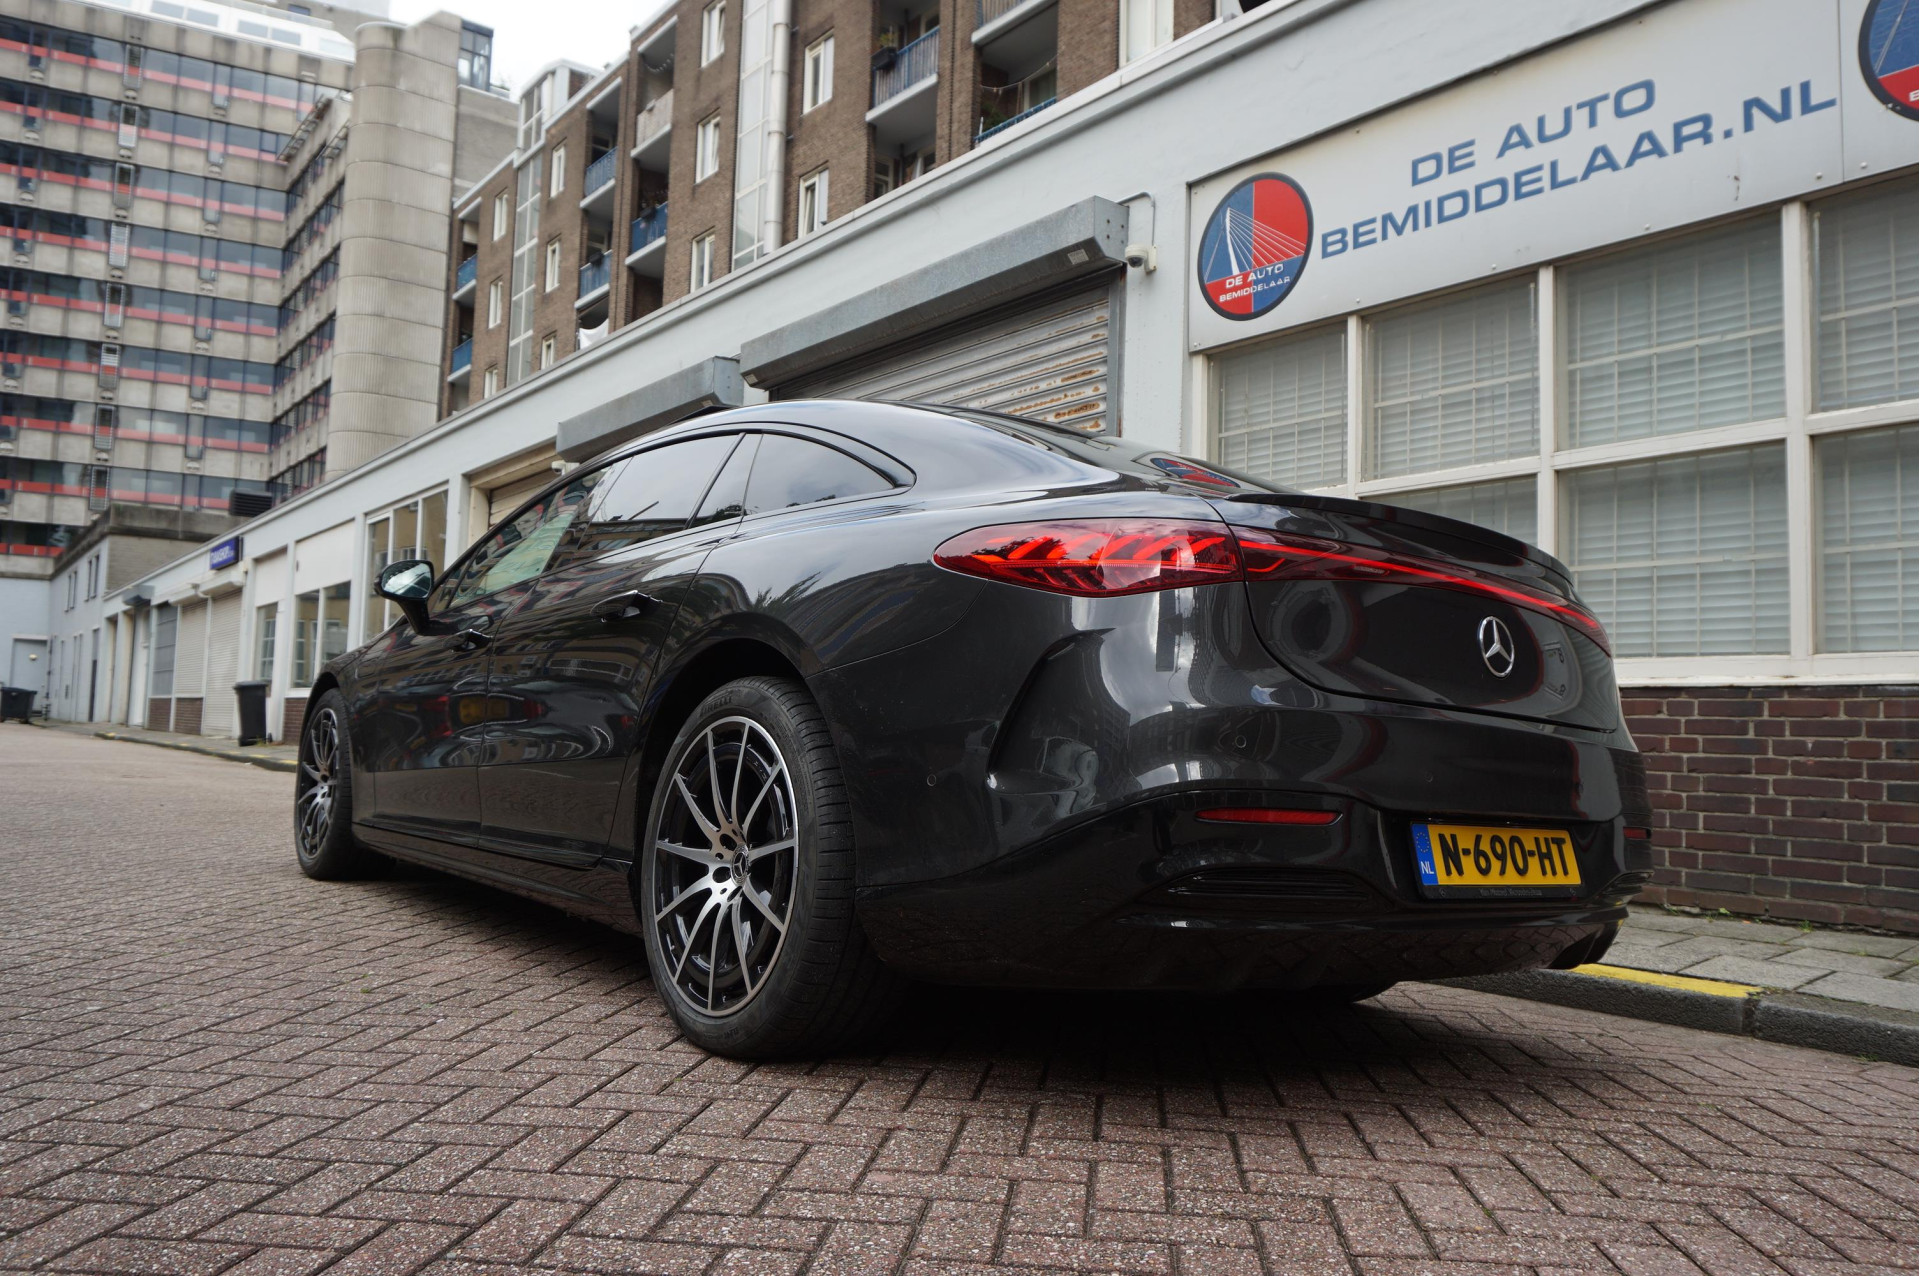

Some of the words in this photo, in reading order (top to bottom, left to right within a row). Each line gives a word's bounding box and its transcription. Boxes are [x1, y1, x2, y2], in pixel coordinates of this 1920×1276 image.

[1411, 140, 1475, 187] DE
[1497, 80, 1655, 160] AUTO
[1321, 81, 1837, 259] BEMIDDELAAR.NL
[1219, 276, 1290, 302] BEMIDDELAAR
[1225, 276, 1242, 288] DE
[1247, 265, 1283, 283] AUTO
[1420, 861, 1434, 875] NL
[1438, 833, 1570, 876] N-690-HT
